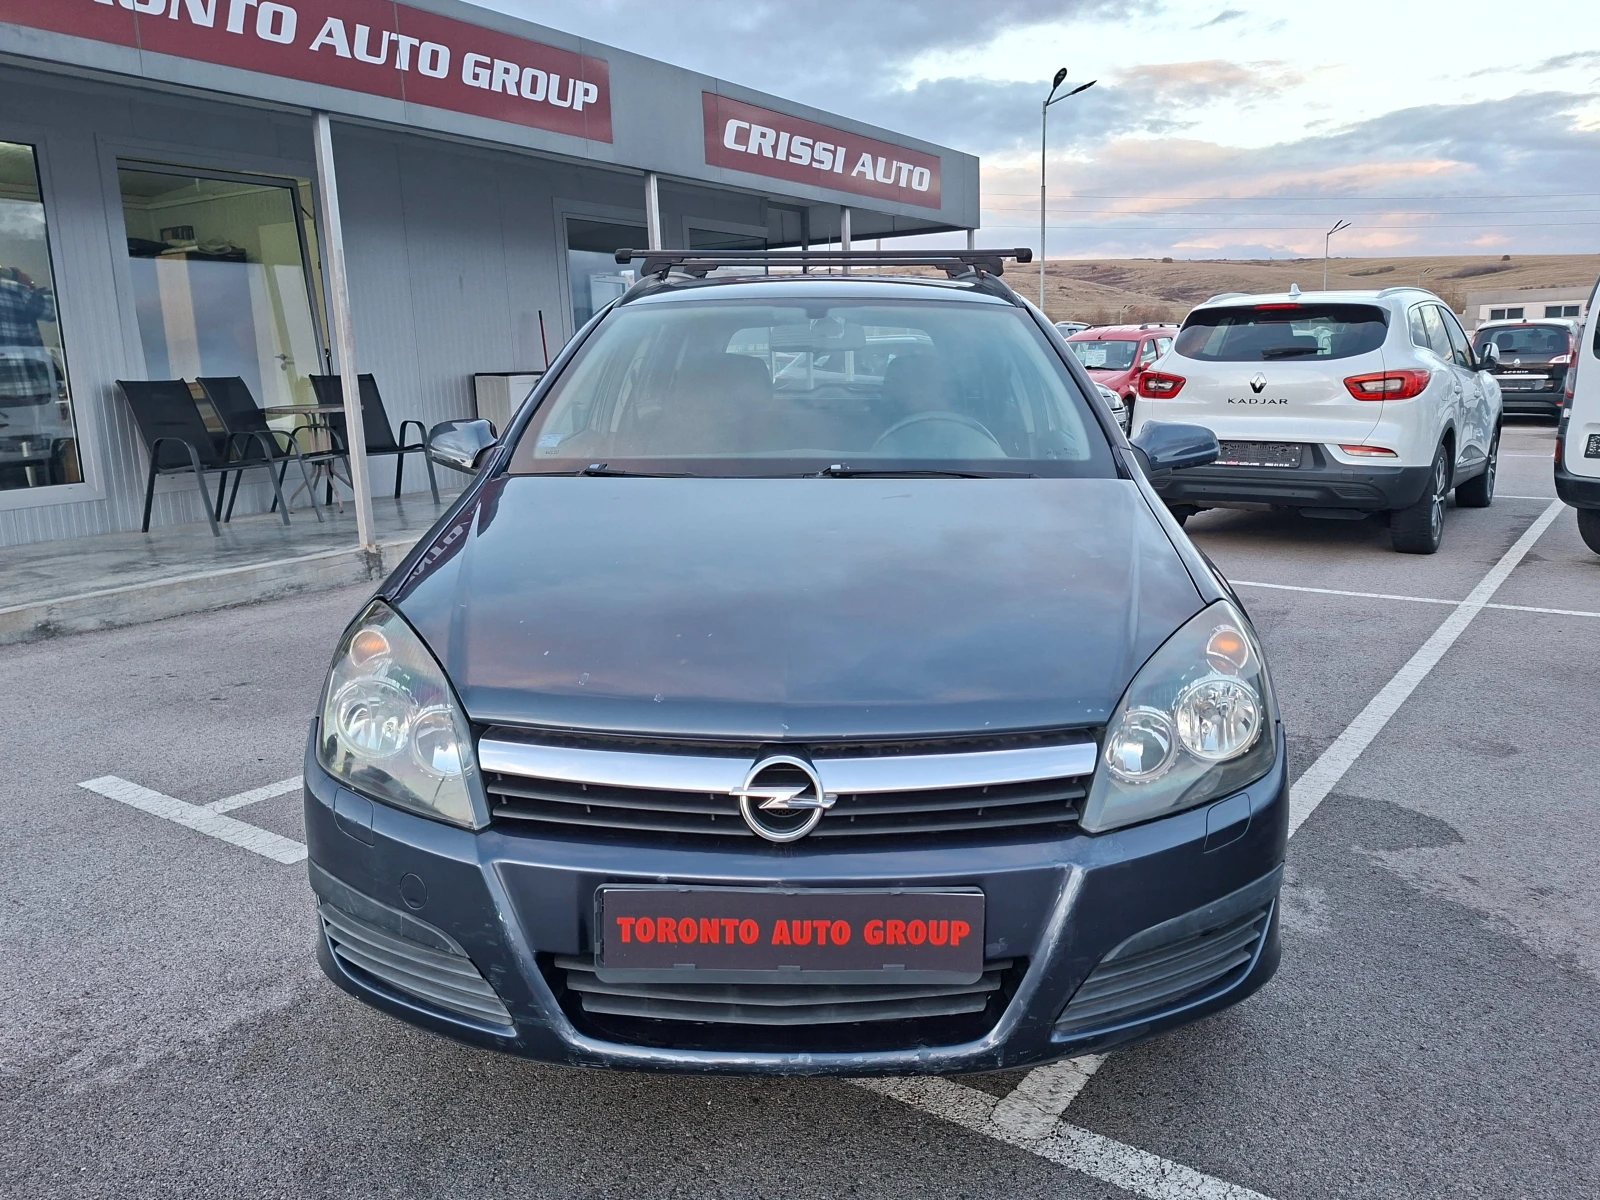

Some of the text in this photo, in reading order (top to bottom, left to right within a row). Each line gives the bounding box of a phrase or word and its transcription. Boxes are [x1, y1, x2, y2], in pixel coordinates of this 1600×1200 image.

[94, 0, 598, 112] NTO AUTO GROUP
[723, 118, 931, 192] CRISSI AUTO
[1227, 397, 1289, 405] KADJAR
[616, 916, 971, 947] TORONTO AUTO GROUP
